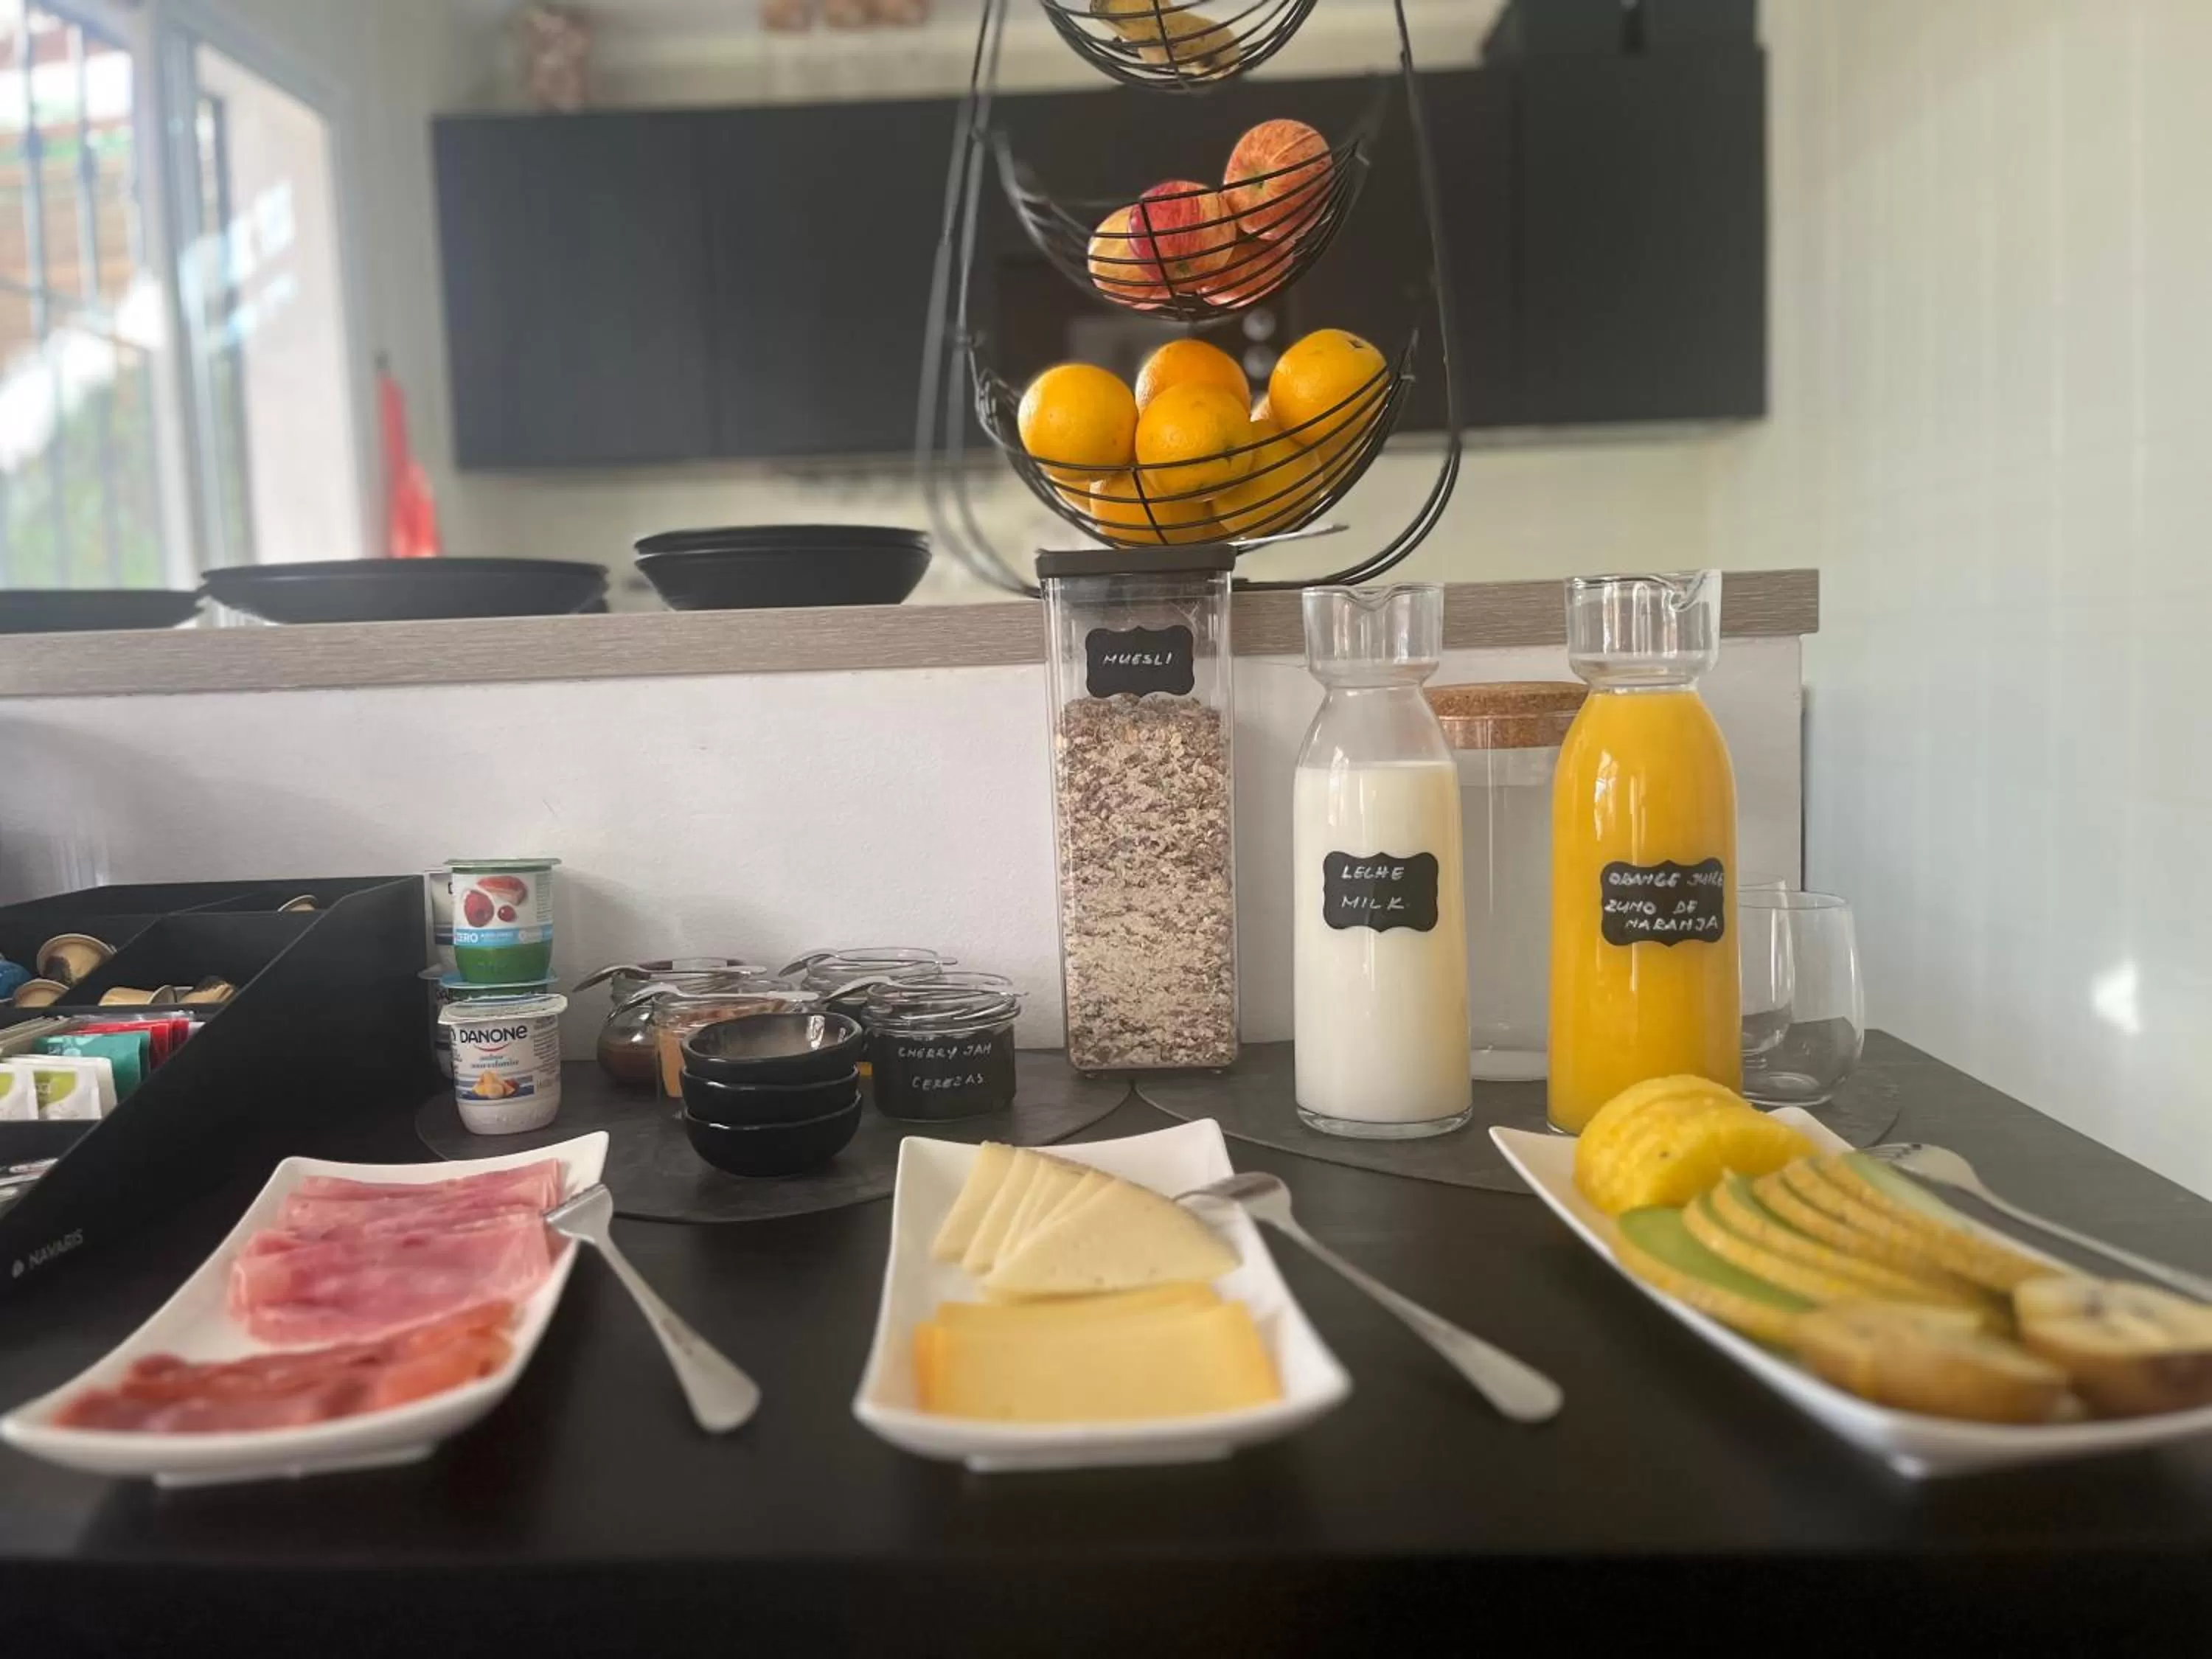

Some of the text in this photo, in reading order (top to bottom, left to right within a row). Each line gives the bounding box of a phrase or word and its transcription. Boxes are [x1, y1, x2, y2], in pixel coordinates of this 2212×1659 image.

[1103, 652, 1172, 666] MUESLI
[1341, 863, 1405, 880] LECHE
[1608, 872, 1681, 888] ORANGE
[1341, 896, 1405, 911] MILK
[1604, 899, 1698, 915] ZUMO DE
[1624, 915, 1719, 932] NARANJA
[897, 1043, 992, 1060] CHERRY JAM
[911, 1074, 984, 1091] CEREZAS
